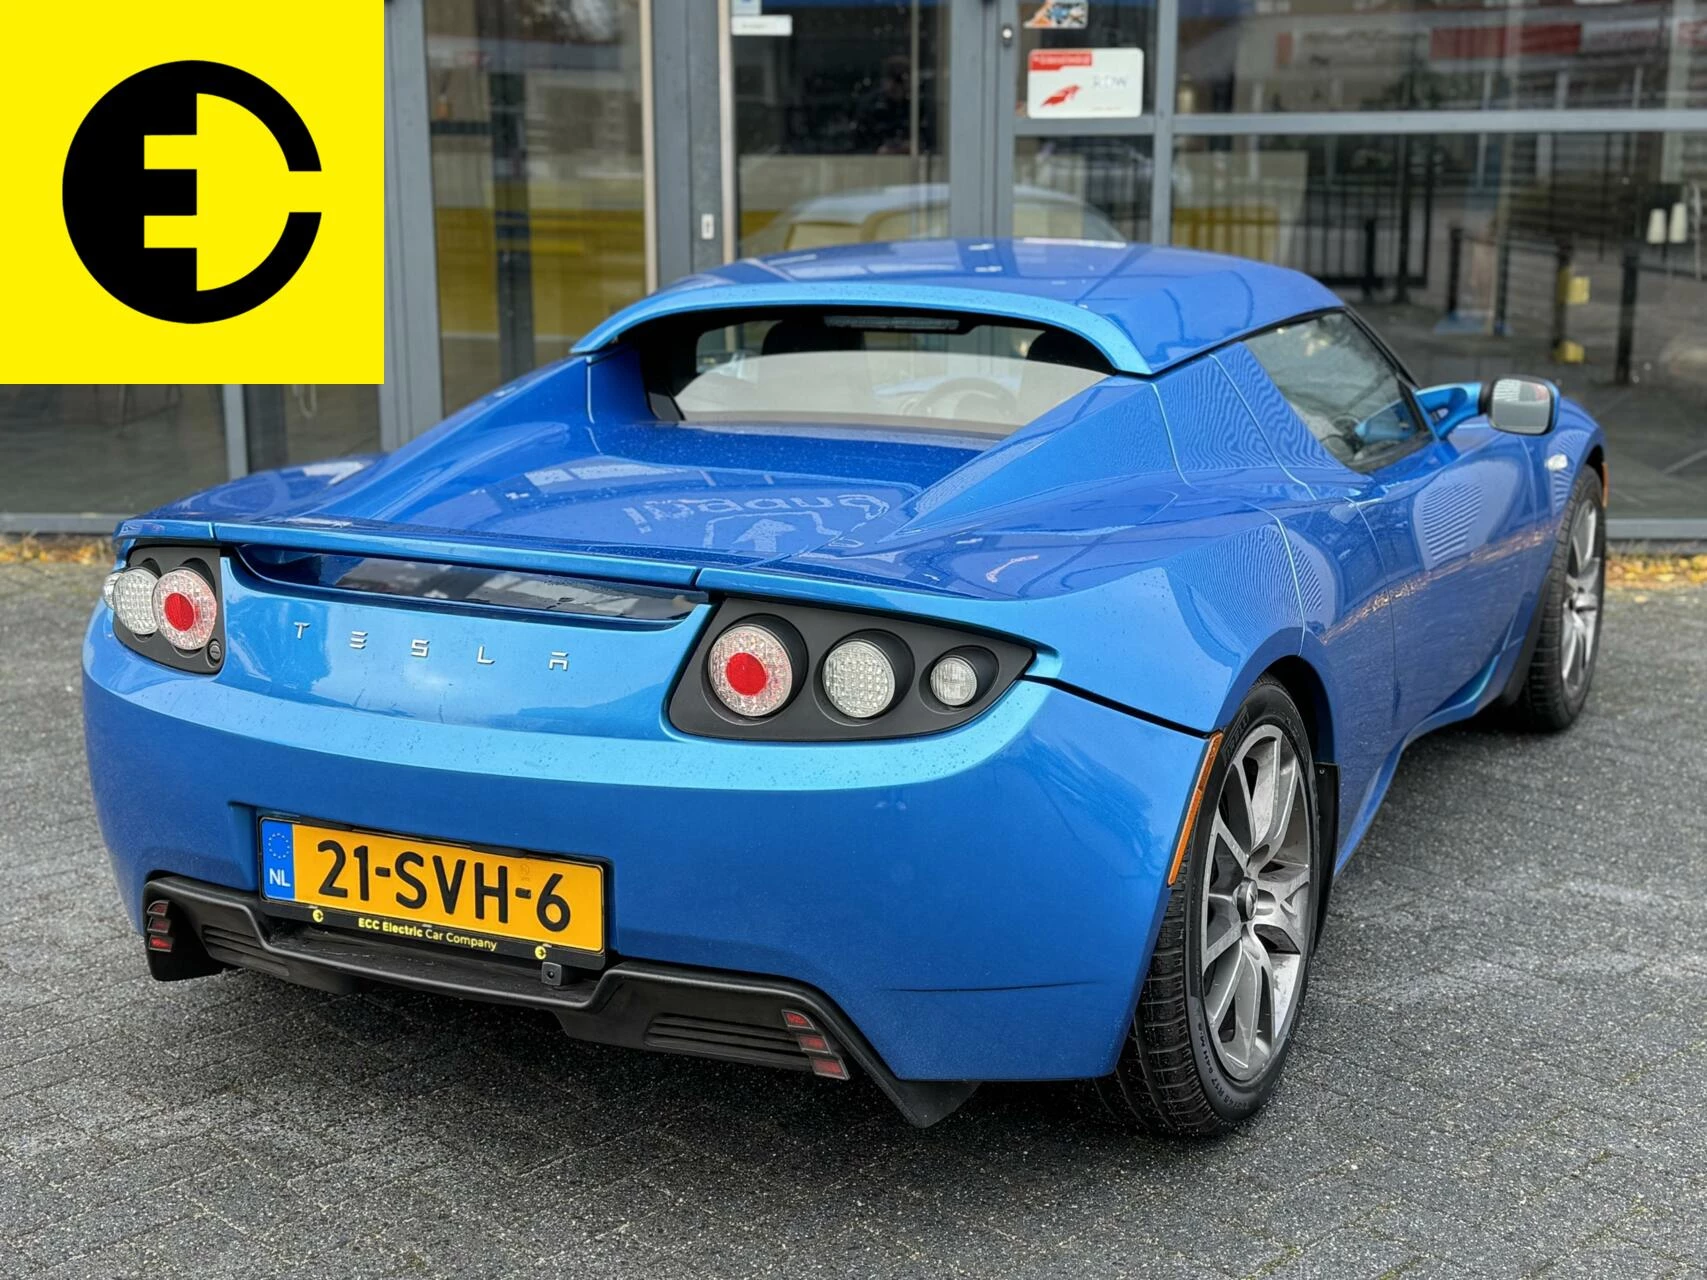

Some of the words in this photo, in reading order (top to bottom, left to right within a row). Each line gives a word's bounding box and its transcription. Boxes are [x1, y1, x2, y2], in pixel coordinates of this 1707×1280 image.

[293, 621, 570, 671] TESLA
[269, 868, 290, 888] NL
[317, 839, 571, 932] 21-SVH-6
[358, 917, 380, 930] ECC
[382, 921, 423, 938] Electric
[425, 928, 443, 941] Car
[446, 932, 497, 952] Company
